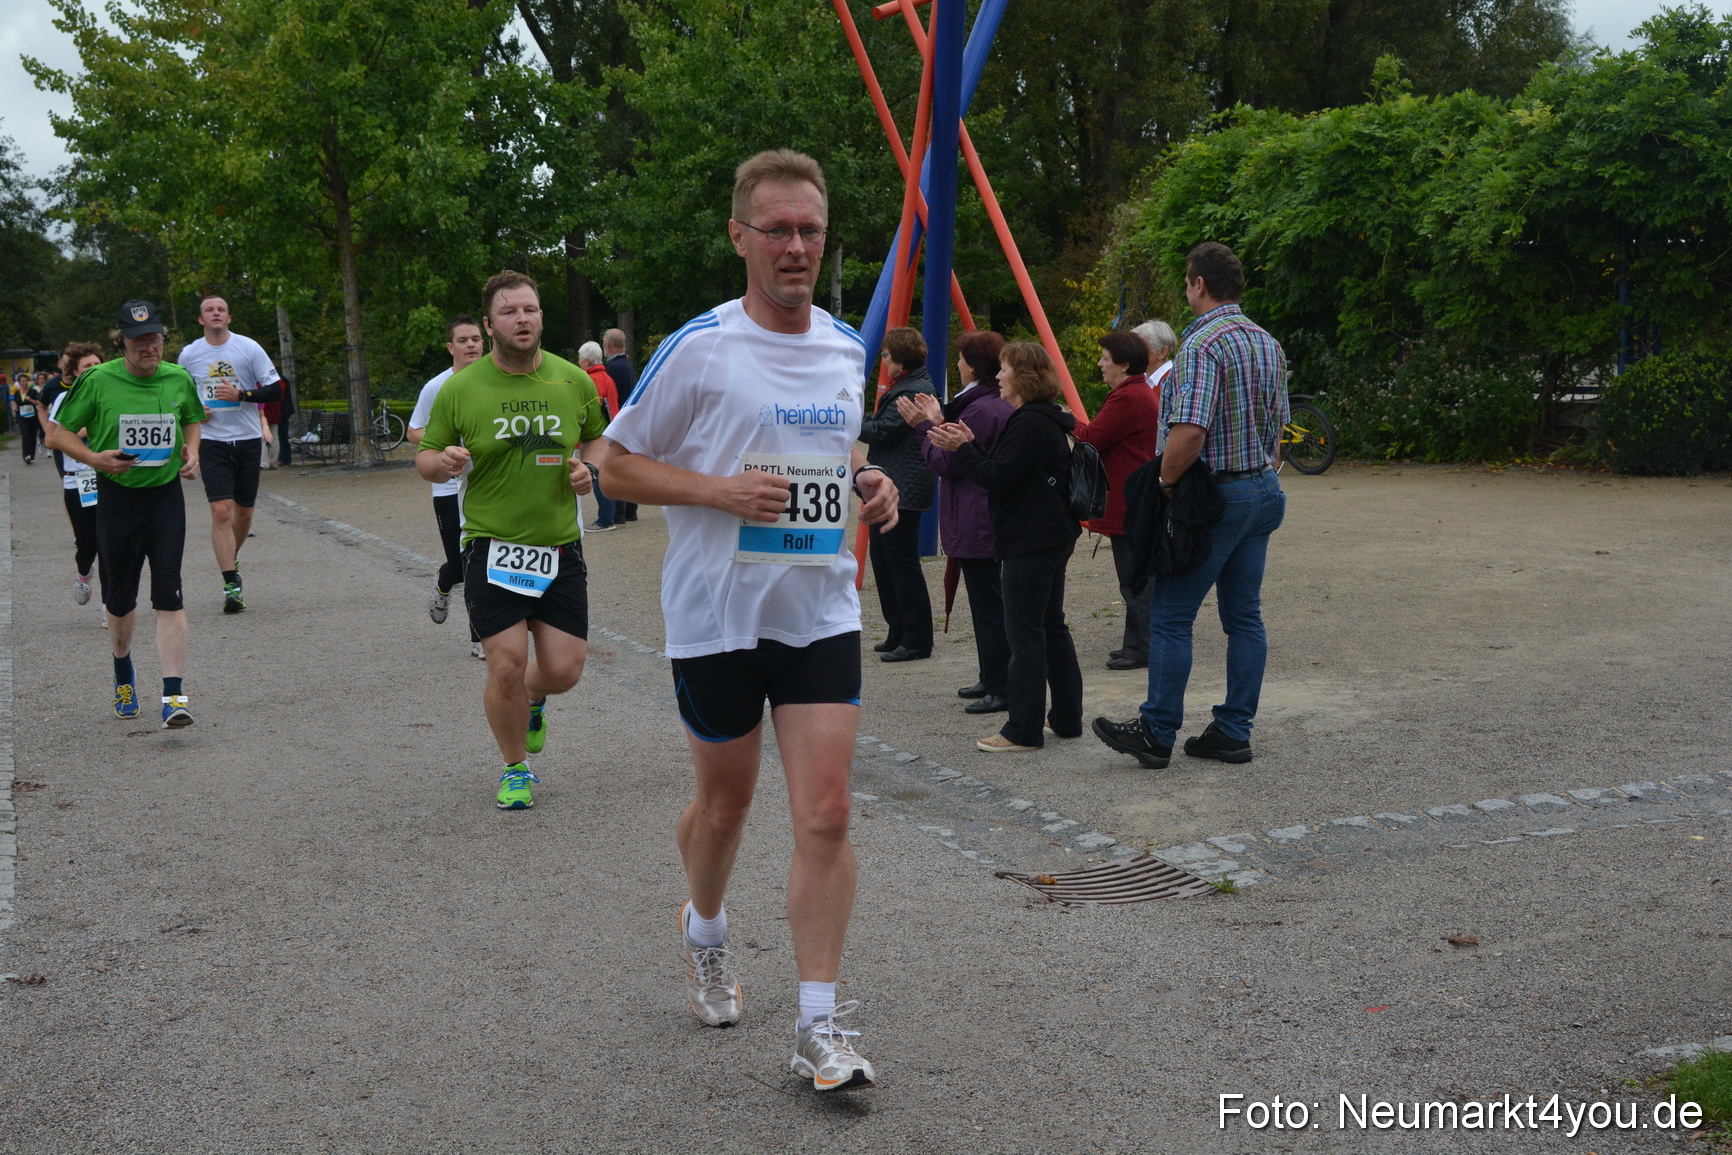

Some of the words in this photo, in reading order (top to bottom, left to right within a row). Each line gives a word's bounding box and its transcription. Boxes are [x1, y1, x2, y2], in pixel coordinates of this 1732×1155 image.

[501, 399, 549, 414] FÜRTH
[774, 402, 846, 425] heinloth
[125, 426, 171, 446] 3364
[493, 414, 563, 440] 2012
[787, 465, 834, 477] Neumarkt
[783, 533, 815, 550] Rolf
[495, 545, 552, 575] 2320
[509, 575, 535, 588] Mirza
